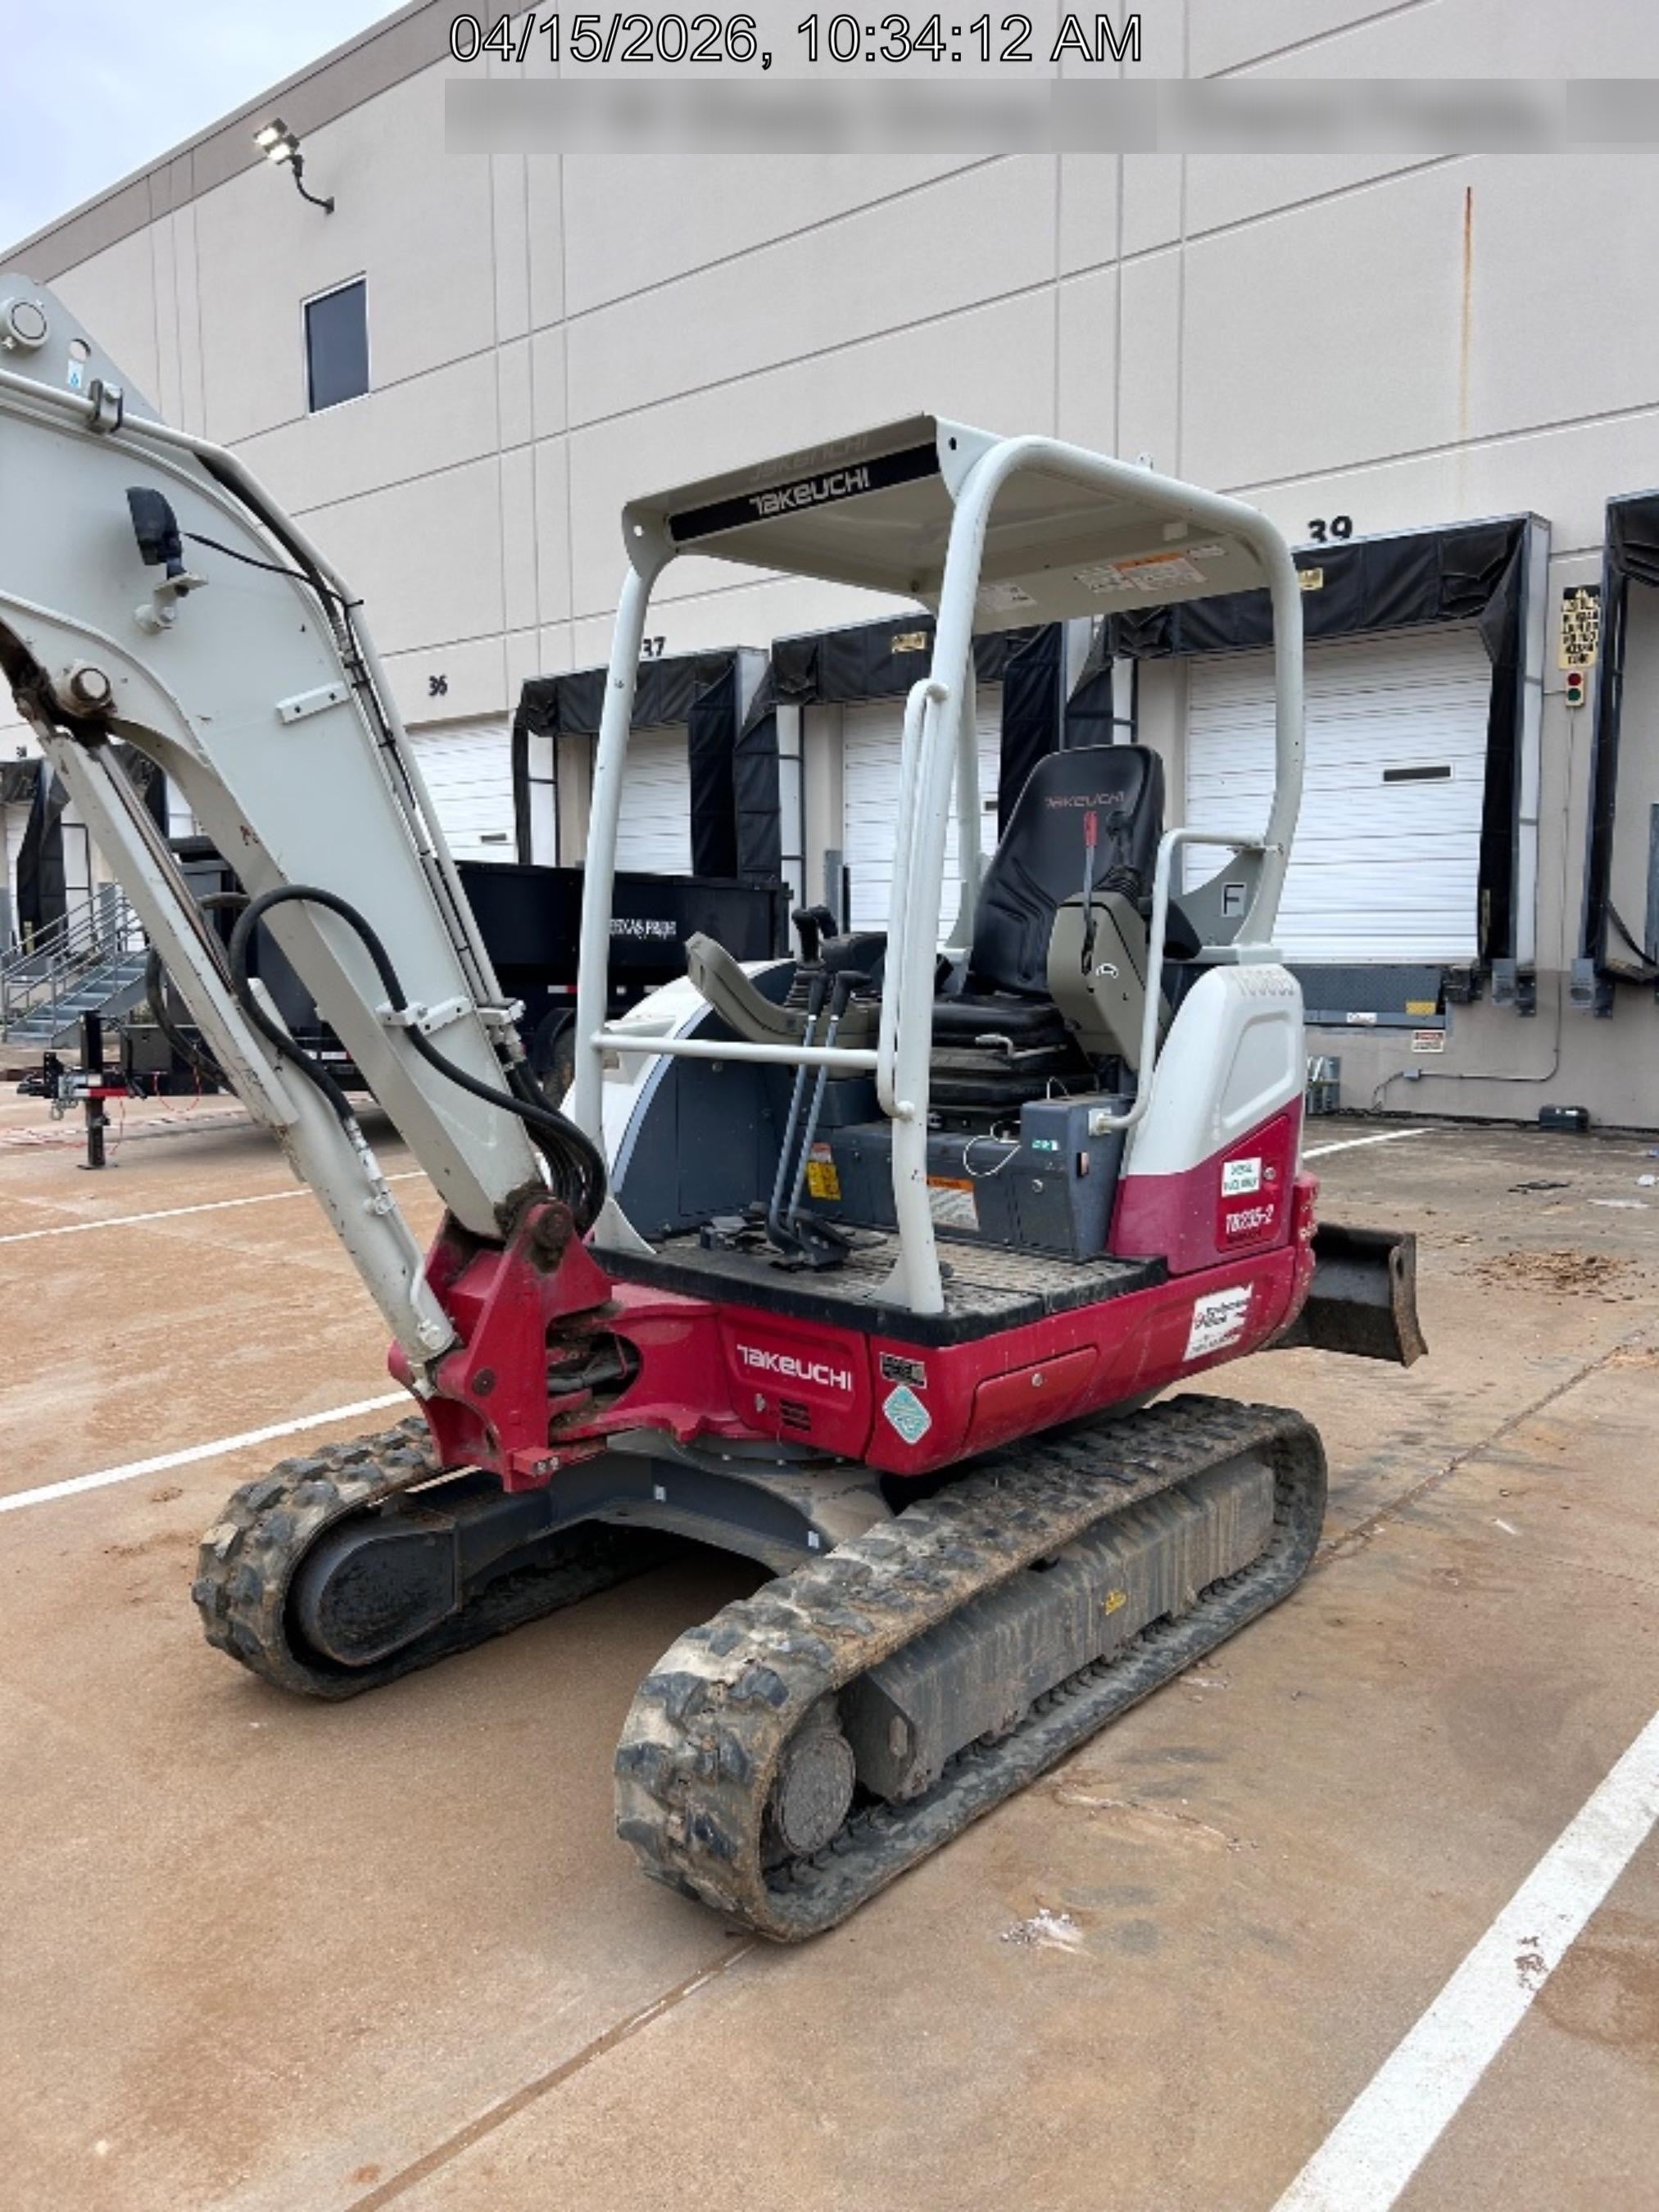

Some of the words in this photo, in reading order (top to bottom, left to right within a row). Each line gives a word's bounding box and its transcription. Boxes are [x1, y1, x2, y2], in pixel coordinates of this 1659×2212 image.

[1308, 514, 1353, 544] 39
[642, 636, 667, 657] 37
[1224, 884, 1244, 914] F
[737, 1344, 853, 1392] TAKEUCHI
